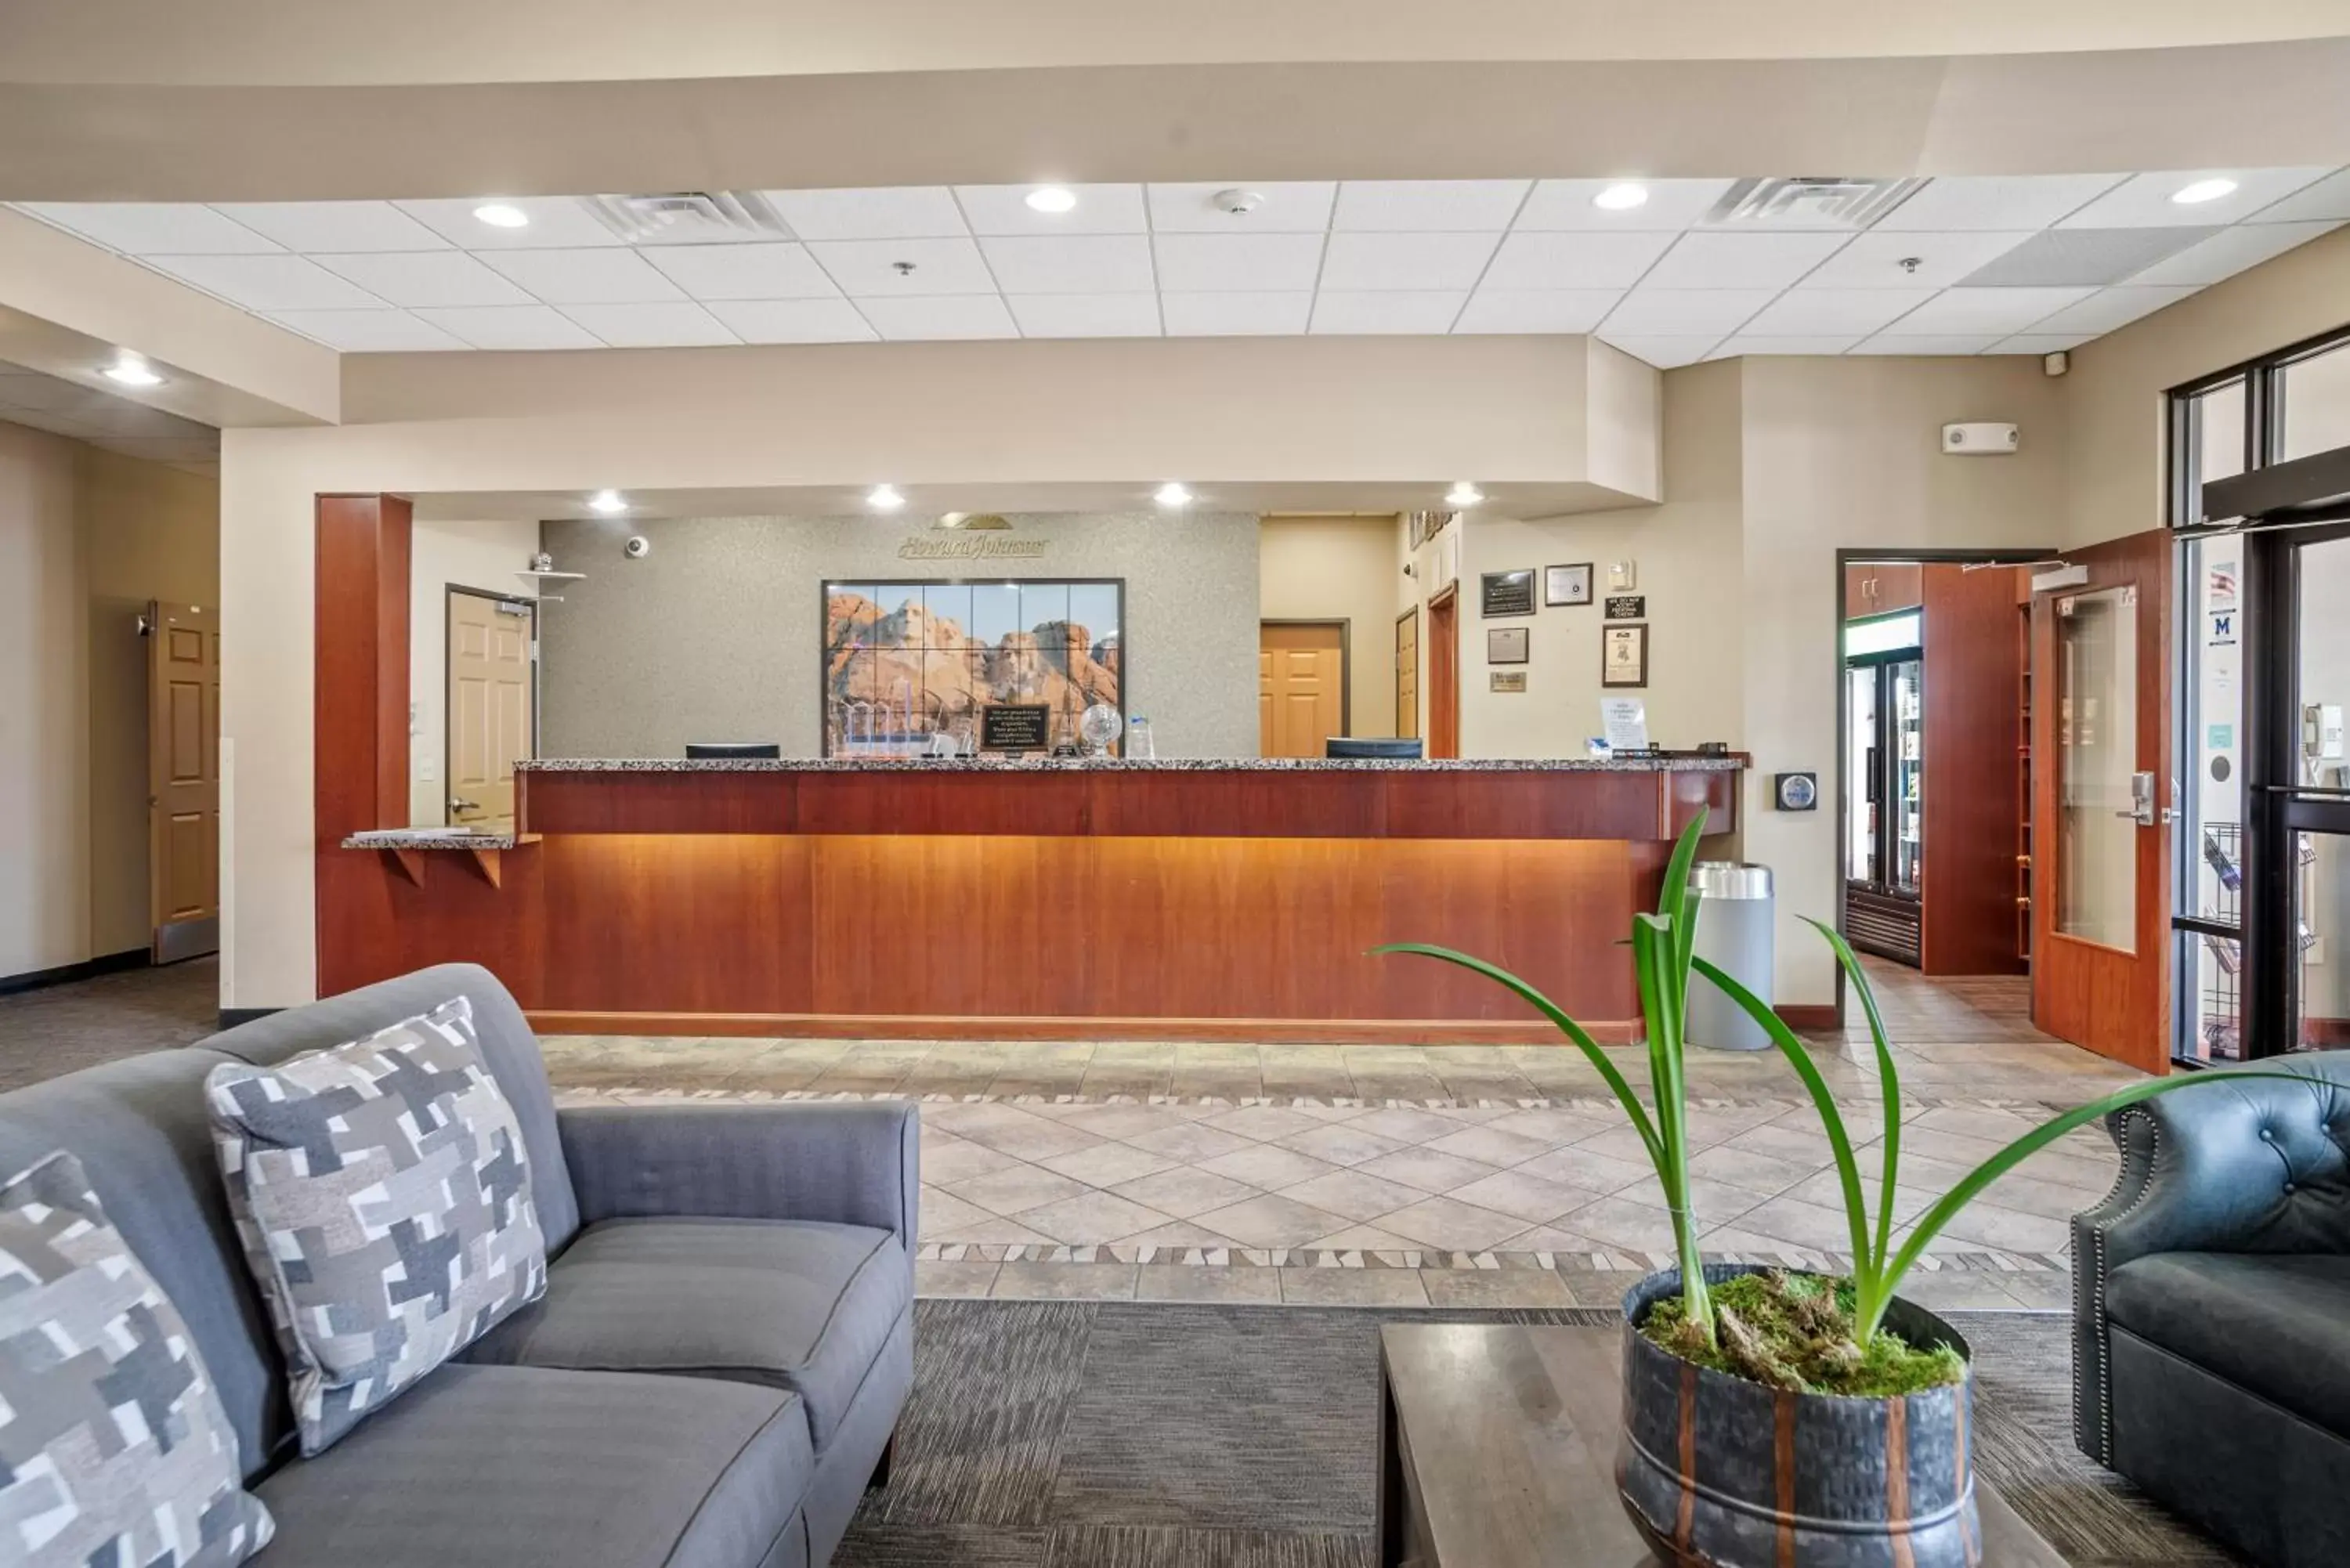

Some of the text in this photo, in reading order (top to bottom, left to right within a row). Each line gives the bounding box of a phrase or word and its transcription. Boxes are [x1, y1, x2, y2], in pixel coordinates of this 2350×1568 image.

[898, 533, 1050, 558] Howard Johnson
[2215, 616, 2231, 635] M
